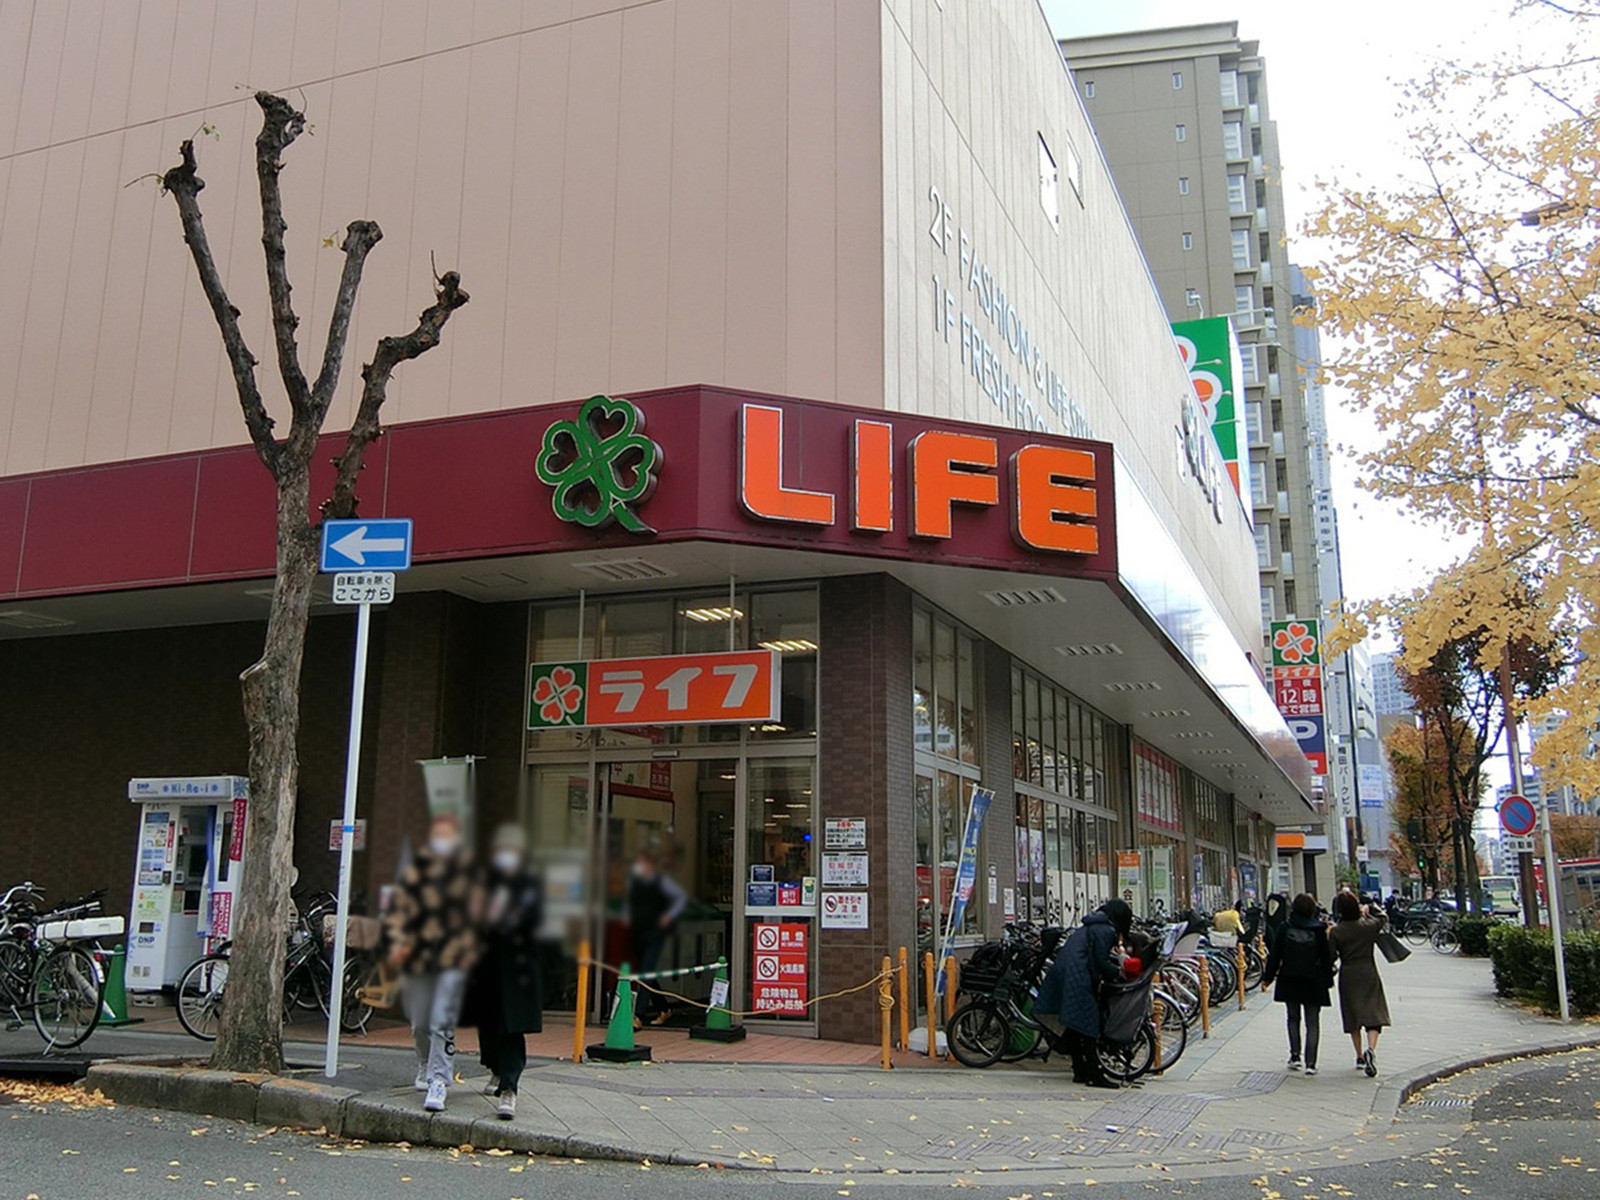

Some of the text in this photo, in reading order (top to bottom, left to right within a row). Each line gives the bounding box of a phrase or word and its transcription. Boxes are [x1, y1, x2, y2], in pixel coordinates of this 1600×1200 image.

[929, 185, 953, 256] 2F
[958, 227, 1030, 375] FASHION
[1034, 346, 1044, 397] &
[932, 274, 955, 344] 1F
[960, 311, 1011, 422] FRESH
[741, 403, 1099, 555] LIFE
[335, 587, 391, 601] ここから
[600, 663, 758, 713] ライフ
[1277, 666, 1316, 678] ライフ
